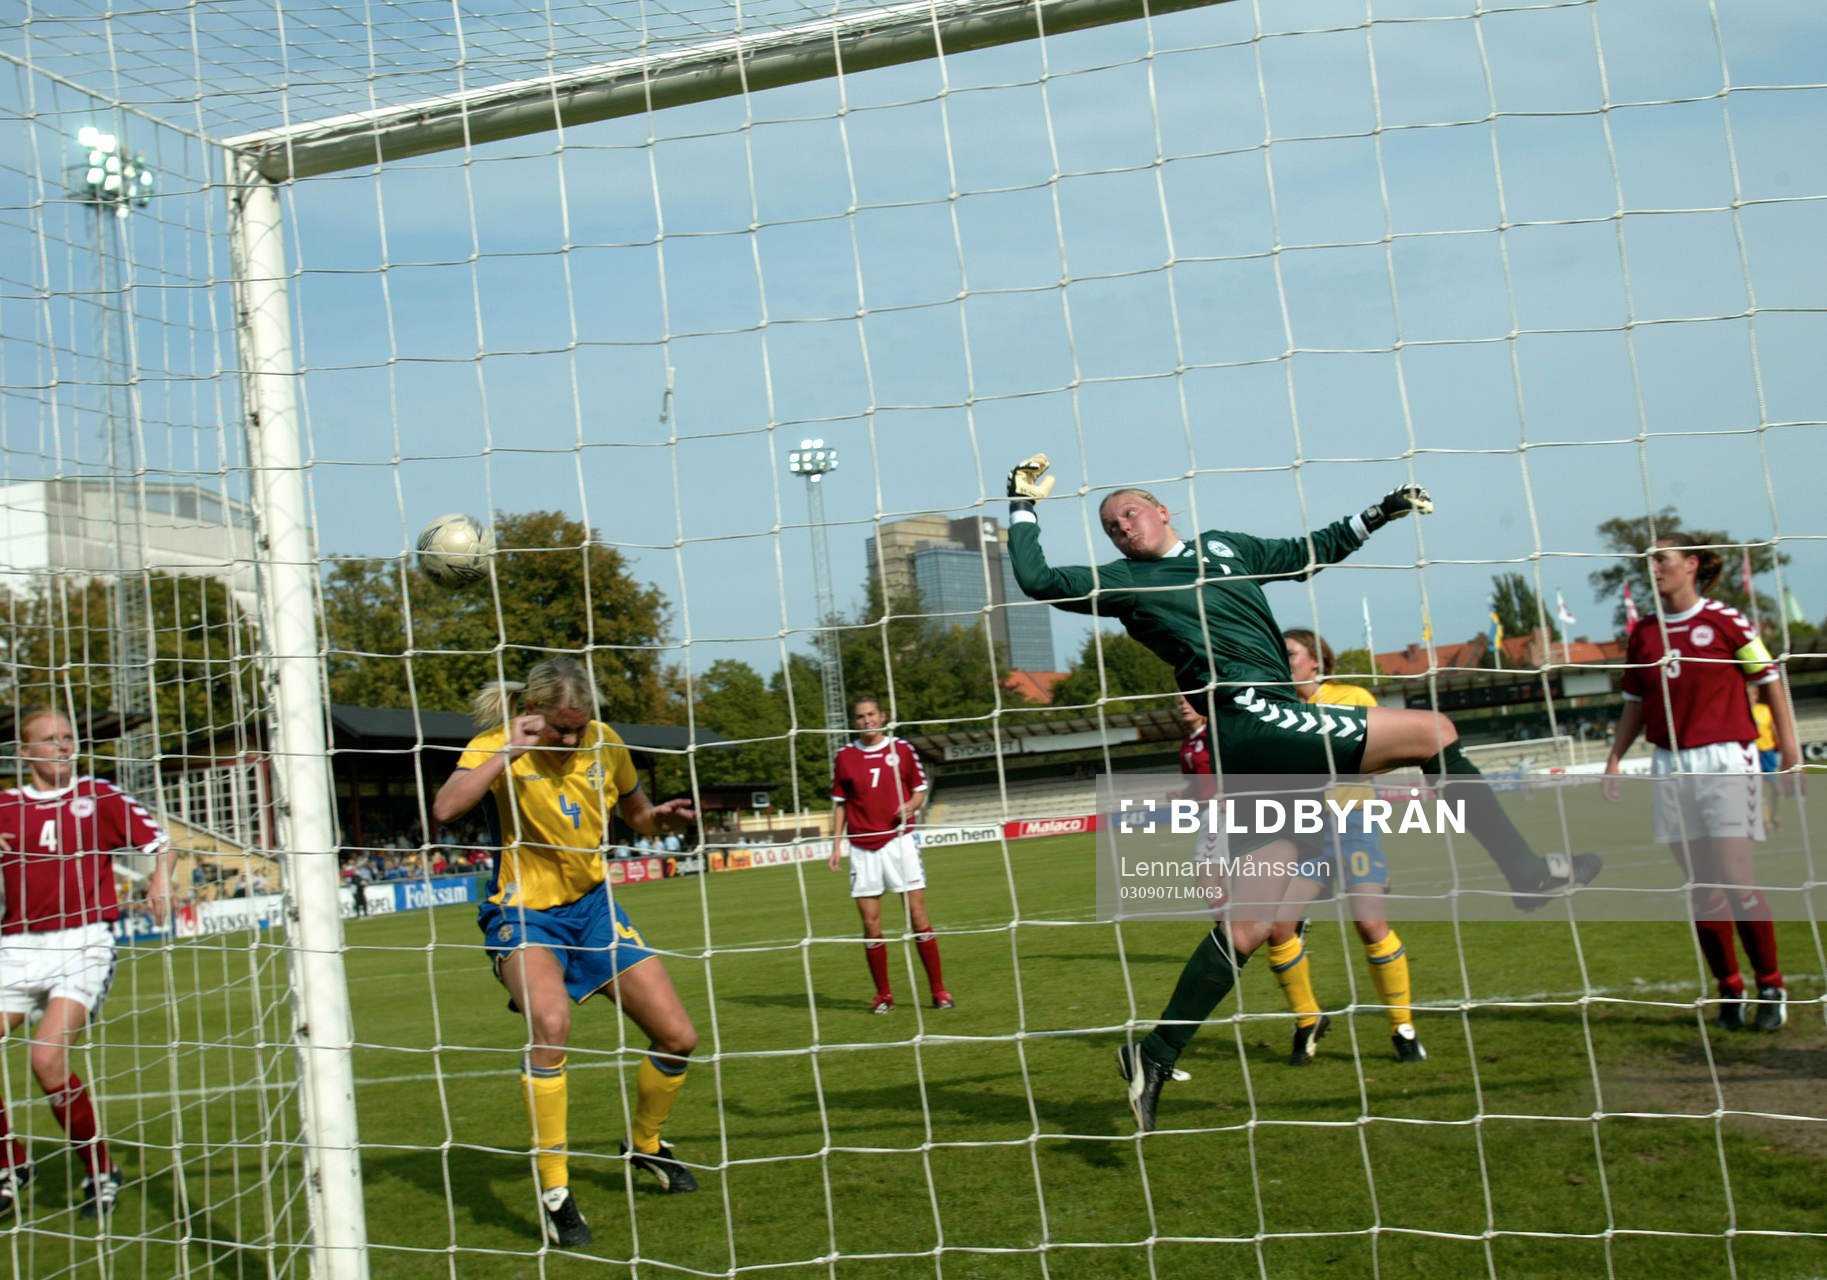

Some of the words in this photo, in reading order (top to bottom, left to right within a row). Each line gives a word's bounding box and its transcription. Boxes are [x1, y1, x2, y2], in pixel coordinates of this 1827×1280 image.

[869, 767, 881, 788] 7
[558, 793, 581, 829] 4
[38, 819, 57, 852] 4
[925, 833, 959, 845] com
[961, 829, 996, 841] hem
[1026, 819, 1081, 834] Malaco
[405, 882, 468, 909] Folksam
[616, 921, 645, 947] 4
